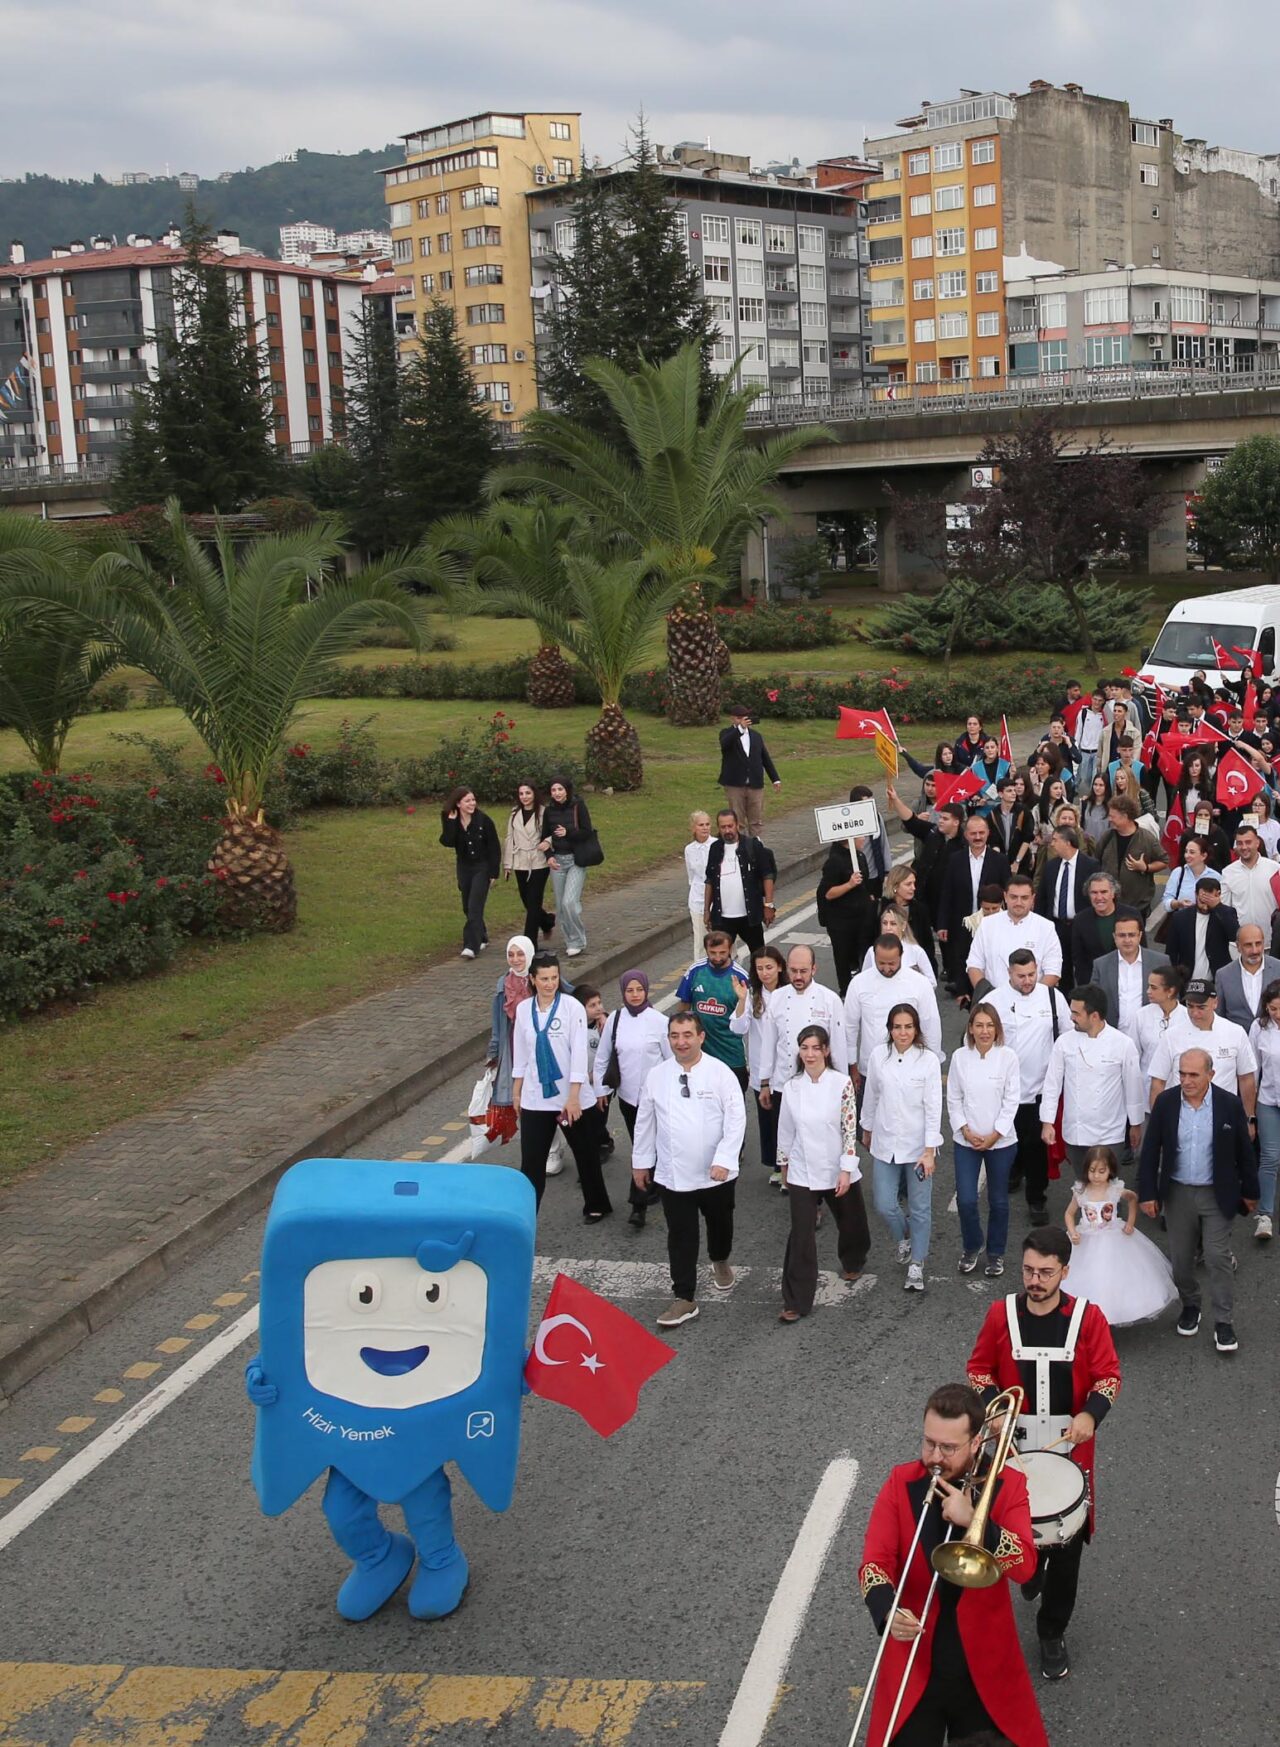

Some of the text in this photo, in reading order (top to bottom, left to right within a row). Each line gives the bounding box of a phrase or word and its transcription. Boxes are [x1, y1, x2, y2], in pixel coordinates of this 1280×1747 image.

[832, 818, 865, 831] ÖN BÜRO
[302, 1407, 396, 1441] Hizir Yemek
